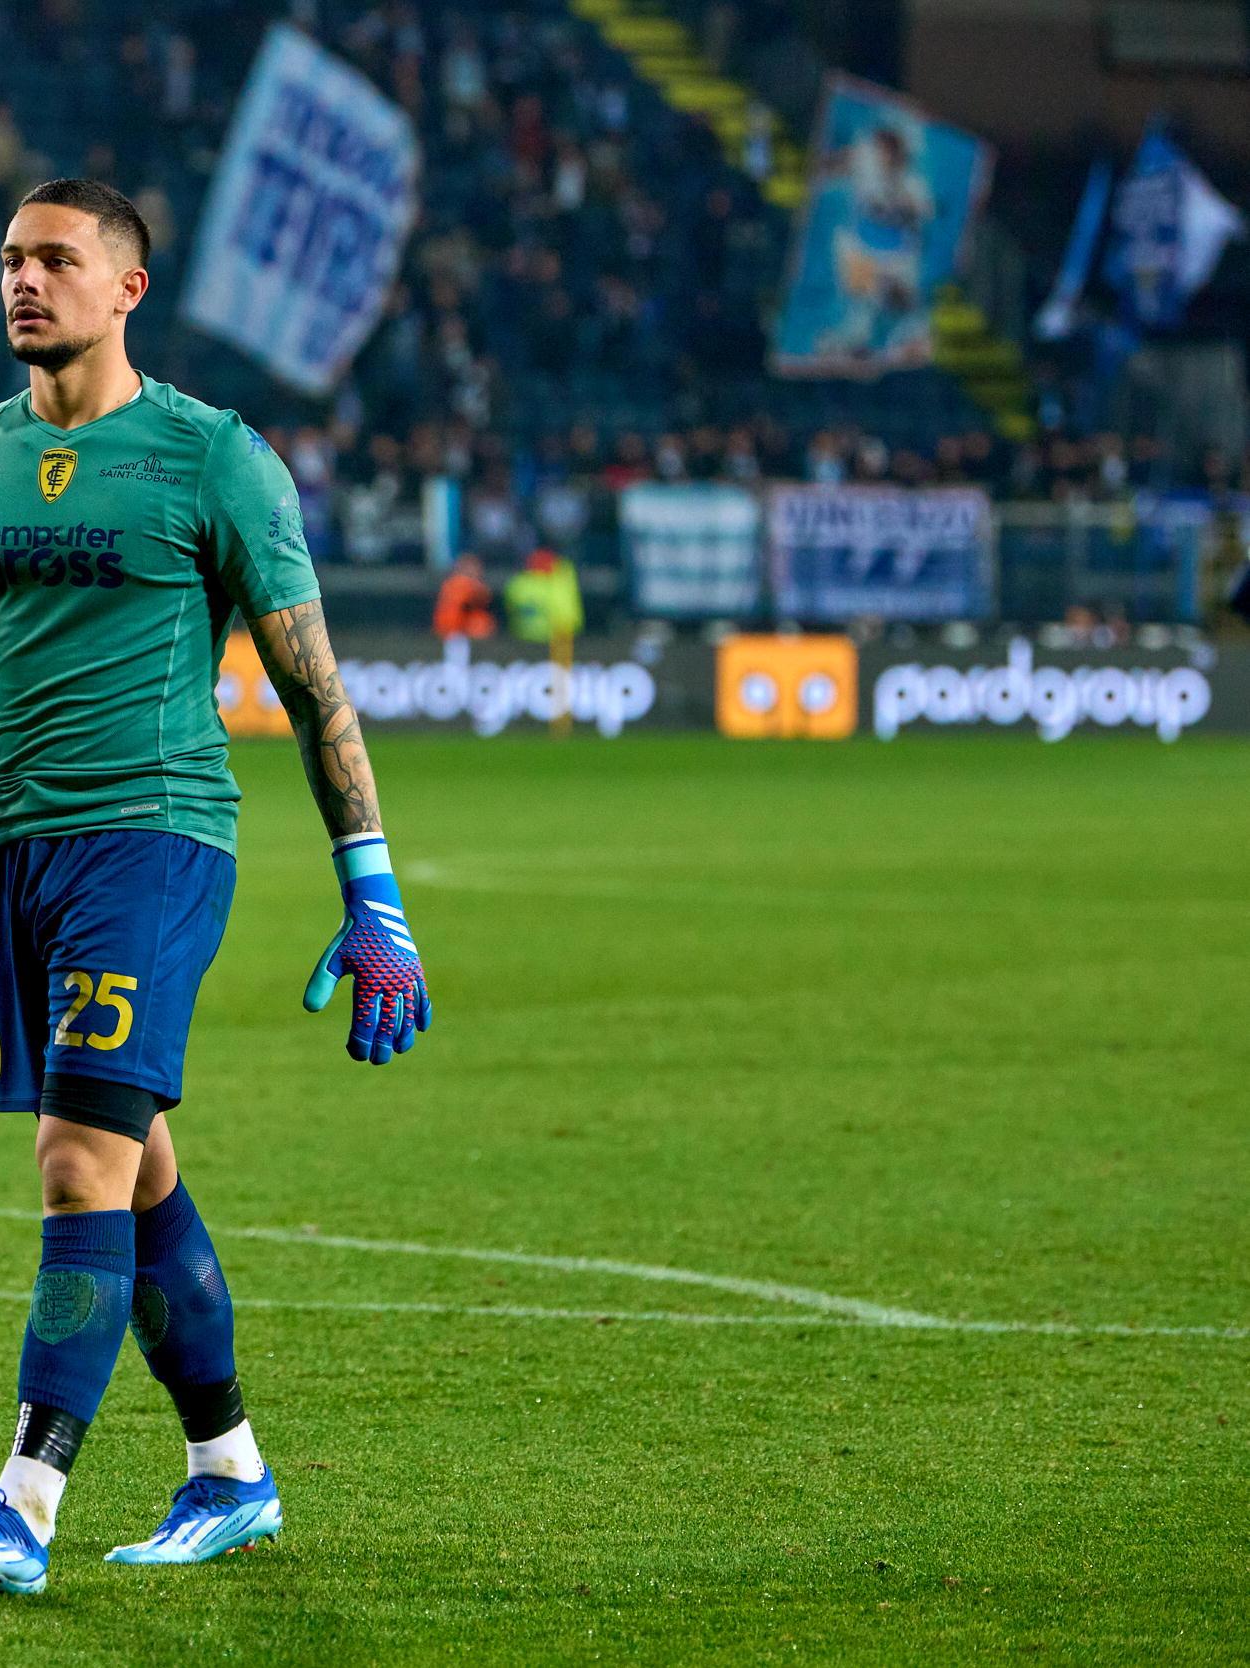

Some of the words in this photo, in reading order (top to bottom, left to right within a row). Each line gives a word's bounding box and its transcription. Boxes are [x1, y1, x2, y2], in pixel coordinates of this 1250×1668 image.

[98, 469, 182, 485] SAINT-GOBAIN
[873, 635, 1212, 743] pardgroup
[54, 971, 138, 1051] 25
